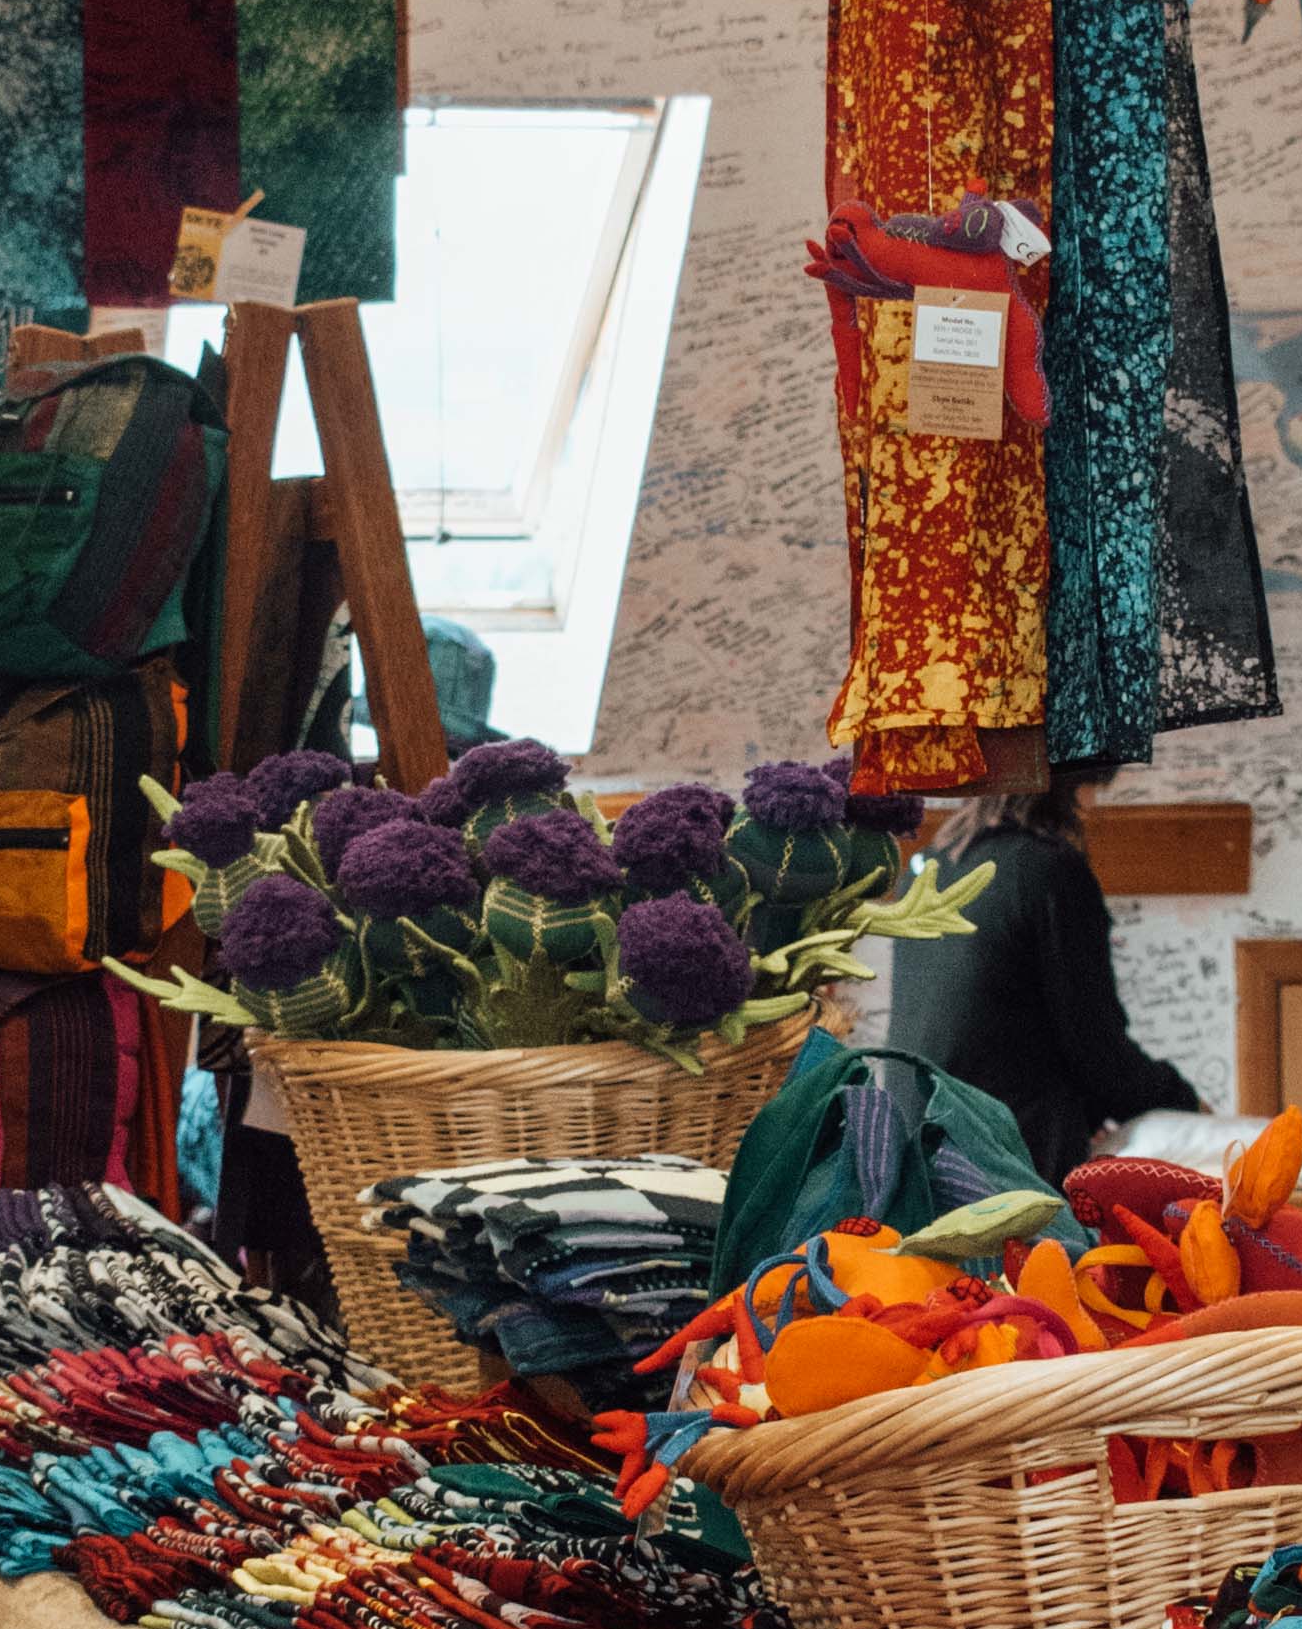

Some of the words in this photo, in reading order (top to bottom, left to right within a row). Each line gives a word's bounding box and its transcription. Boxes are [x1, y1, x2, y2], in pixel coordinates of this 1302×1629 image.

[941, 315, 963, 324] Model
[932, 395, 950, 406] Skye
[952, 396, 975, 406] Batiks
